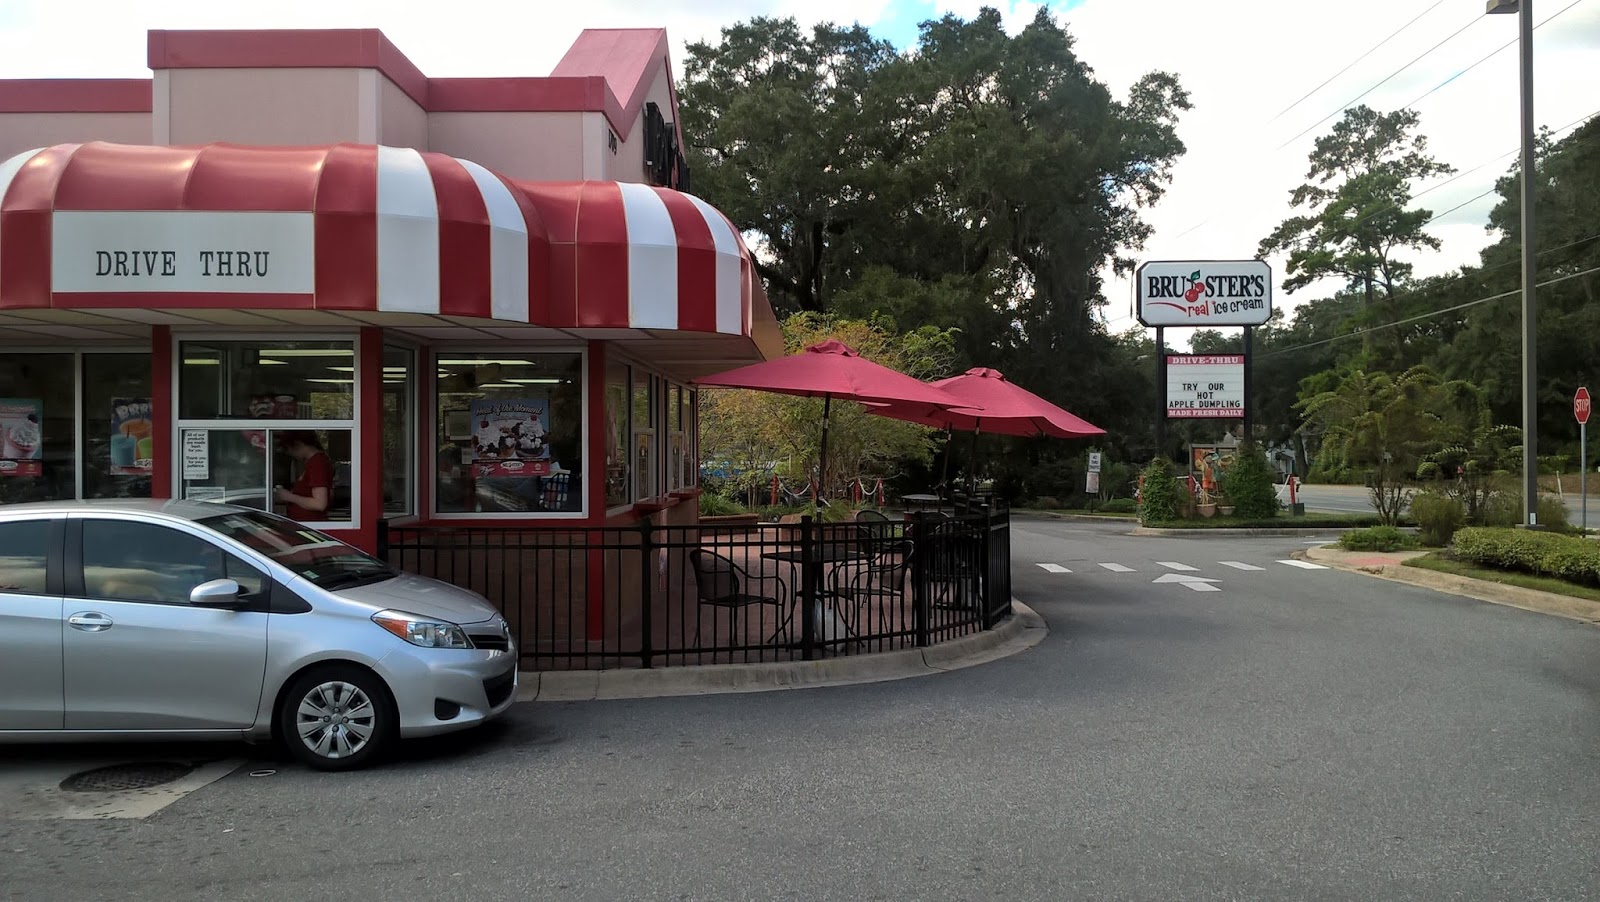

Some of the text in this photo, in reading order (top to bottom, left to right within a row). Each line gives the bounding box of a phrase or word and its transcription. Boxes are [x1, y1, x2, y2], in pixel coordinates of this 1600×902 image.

[95, 251, 270, 277] DRIVE THRU
[1187, 298, 1264, 317] real ice cream
[1172, 356, 1239, 364] DRIVE-THRU
[1182, 383, 1224, 391] TRY OUR
[1169, 400, 1241, 408] APPLE DUMPLING
[1576, 399, 1588, 412] STOP
